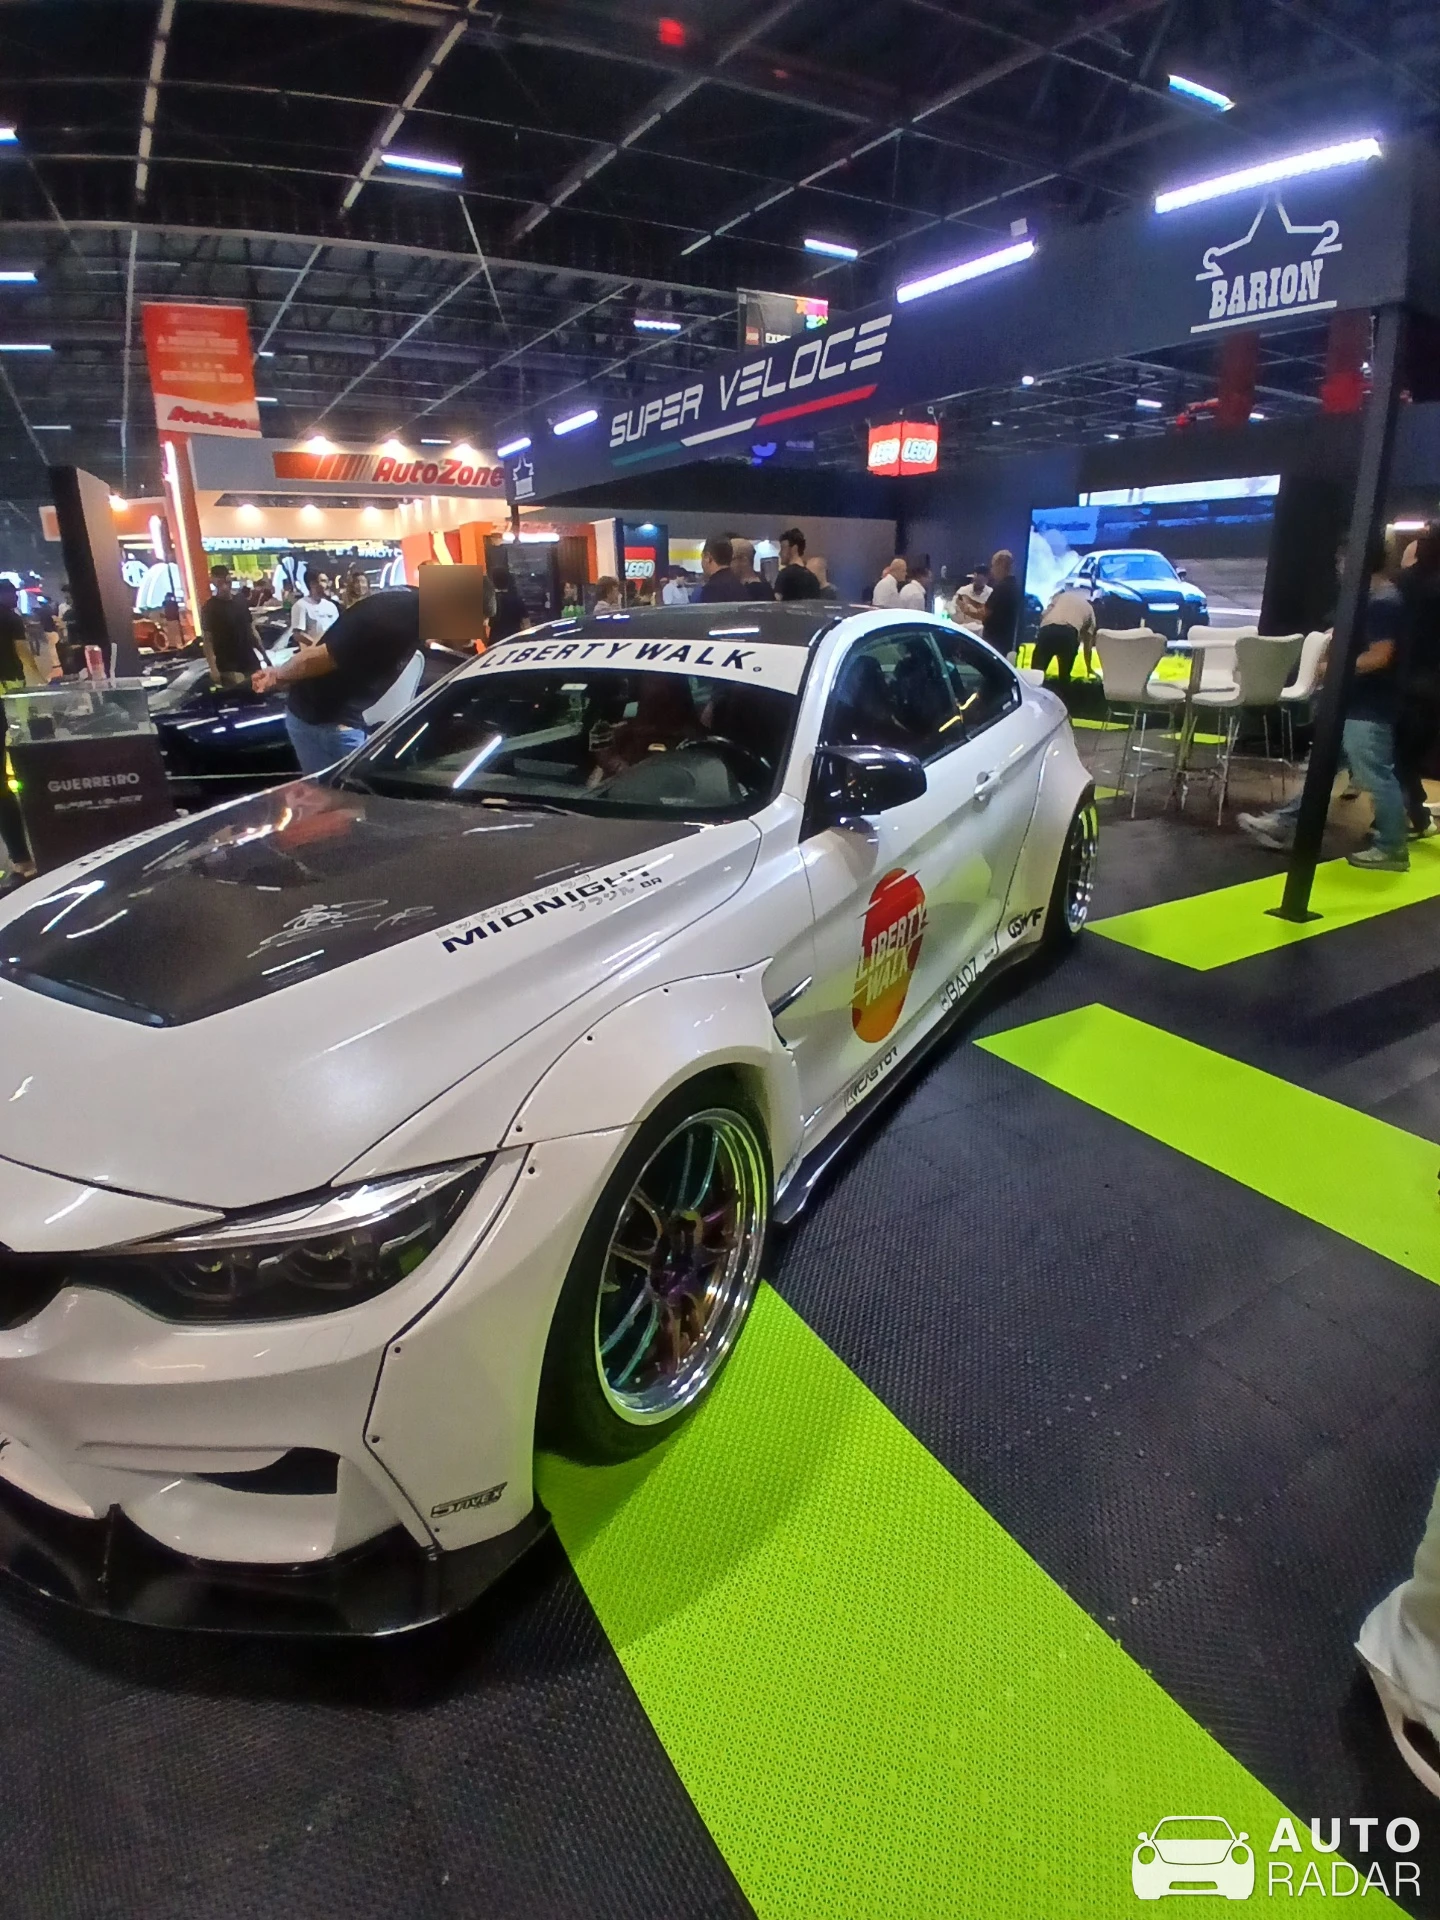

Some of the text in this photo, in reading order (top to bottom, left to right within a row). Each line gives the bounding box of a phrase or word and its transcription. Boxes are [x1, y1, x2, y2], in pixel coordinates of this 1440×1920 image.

[1209, 259, 1323, 319] BARION
[609, 314, 893, 448] SUPER VELOCE
[372, 456, 505, 488] AutoZone
[902, 438, 938, 464] LEGO
[625, 559, 655, 579] LEGO
[480, 642, 632, 669] LIBERTY
[48, 772, 140, 793] GUERREIRO
[441, 863, 651, 954] MIDNIGHT
[857, 903, 926, 980] LIBERTY
[866, 945, 912, 1007] WALK
